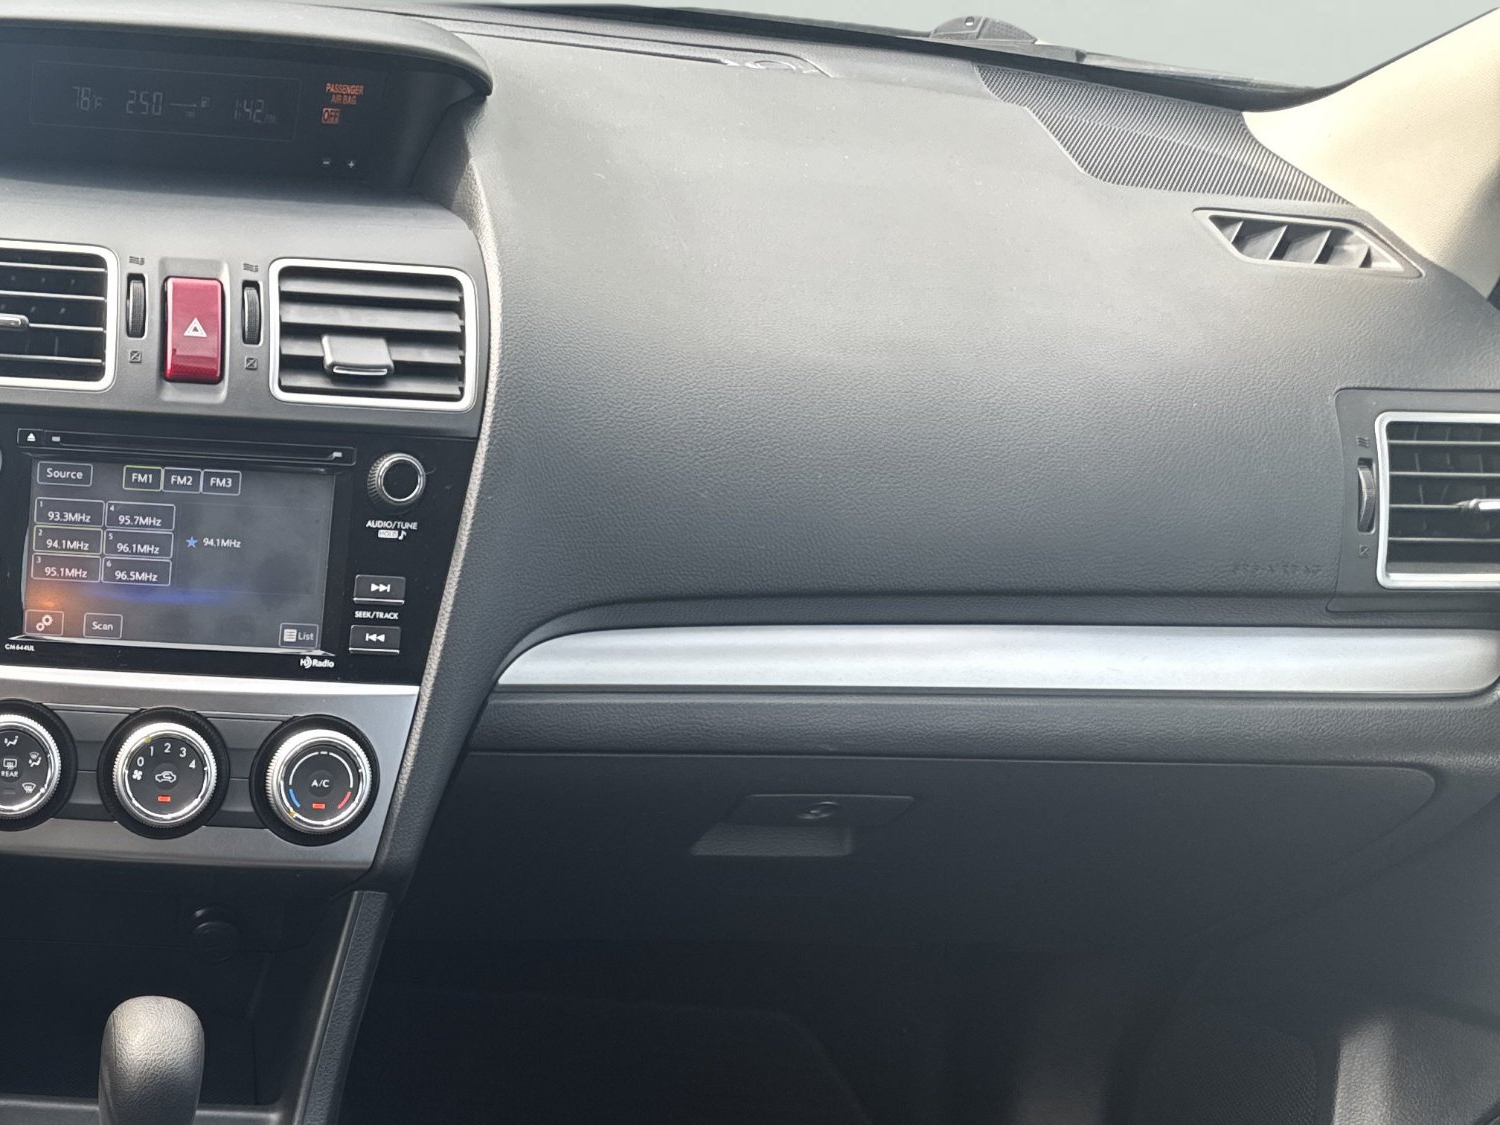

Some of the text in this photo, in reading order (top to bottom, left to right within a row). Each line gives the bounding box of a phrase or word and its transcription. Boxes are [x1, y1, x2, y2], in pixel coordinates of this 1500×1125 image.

[325, 83, 364, 96] PASSENGER
[125, 90, 163, 116] 250
[331, 95, 357, 105] AIR BAG
[322, 108, 339, 122] OFF
[46, 467, 83, 480] Source
[131, 473, 153, 484] FM1
[171, 475, 193, 486] FM2
[210, 477, 232, 488] FM3
[47, 511, 91, 523] 93.3MHz
[118, 515, 162, 527] 95.7MHz
[366, 520, 418, 530] AUDIO/TUNE
[46, 539, 90, 551] 94.1MHz
[203, 538, 241, 548] 94.1MHz
[116, 543, 160, 555] 96.1MHz
[44, 566, 88, 578] 95.1MHz
[114, 571, 158, 583] 96.5MHz
[354, 610, 399, 620] SEEK/TRACK
[91, 621, 113, 631] Scan
[298, 631, 314, 641] List
[312, 658, 335, 668] Radio
[164, 743, 171, 753] 2
[179, 747, 187, 757] 3
[137, 757, 144, 767] 0
[189, 759, 196, 769] 4
[1, 770, 19, 778] REAR
[311, 778, 329, 788] A/C
